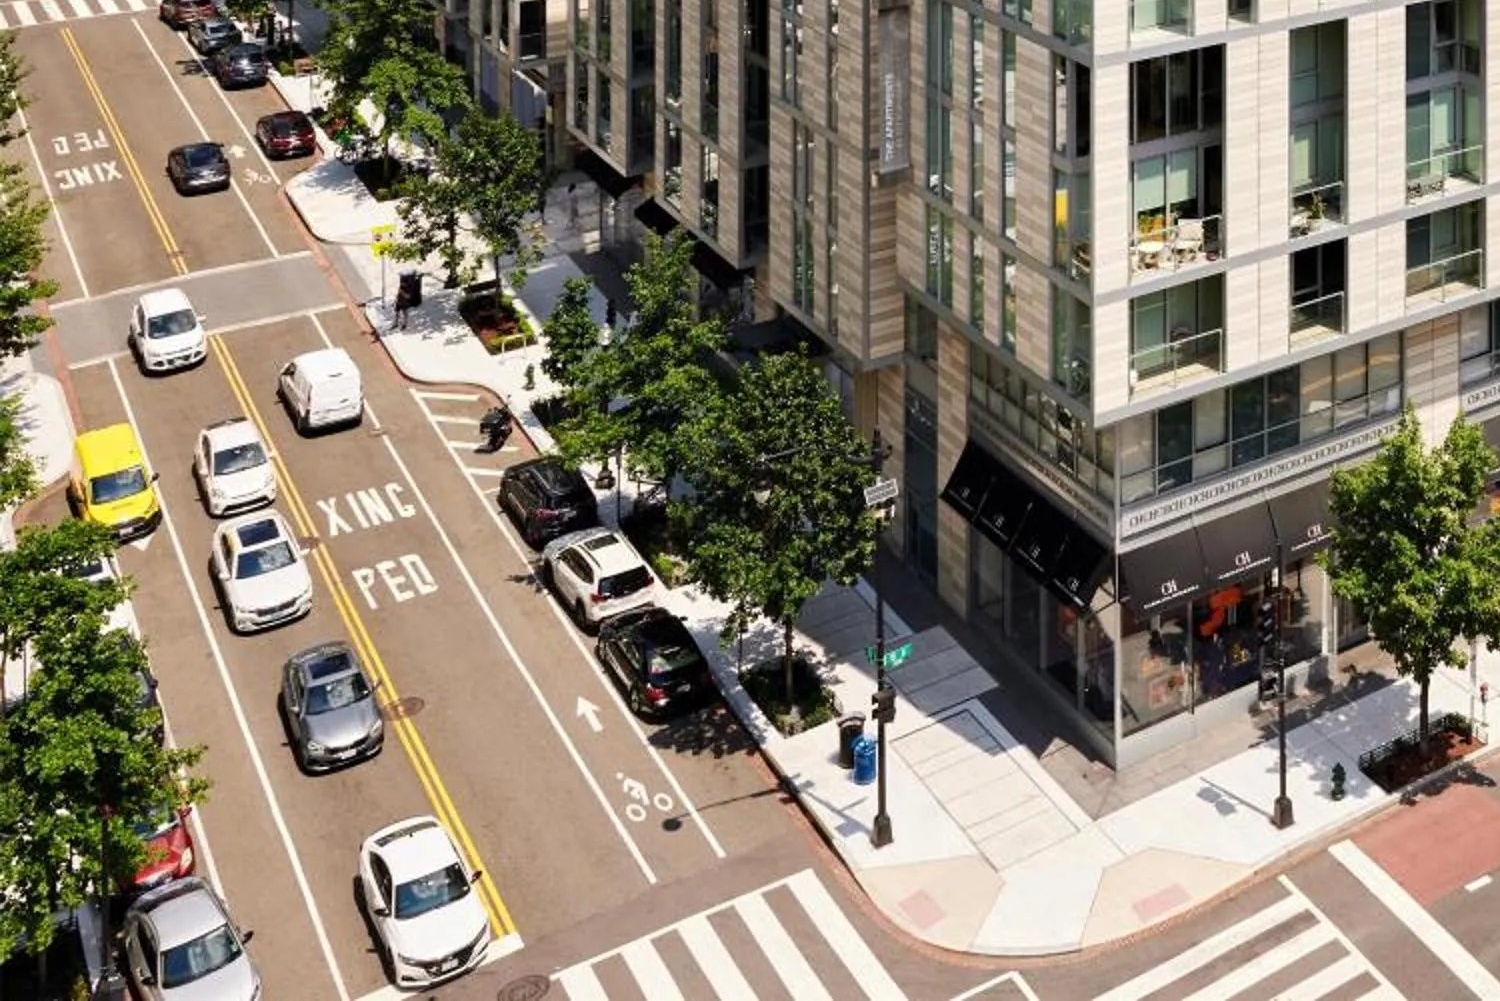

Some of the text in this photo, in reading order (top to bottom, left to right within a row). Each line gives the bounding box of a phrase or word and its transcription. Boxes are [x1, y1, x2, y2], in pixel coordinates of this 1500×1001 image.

[51, 128, 110, 155] PED
[316, 482, 416, 536] XING
[351, 554, 438, 609] PED
